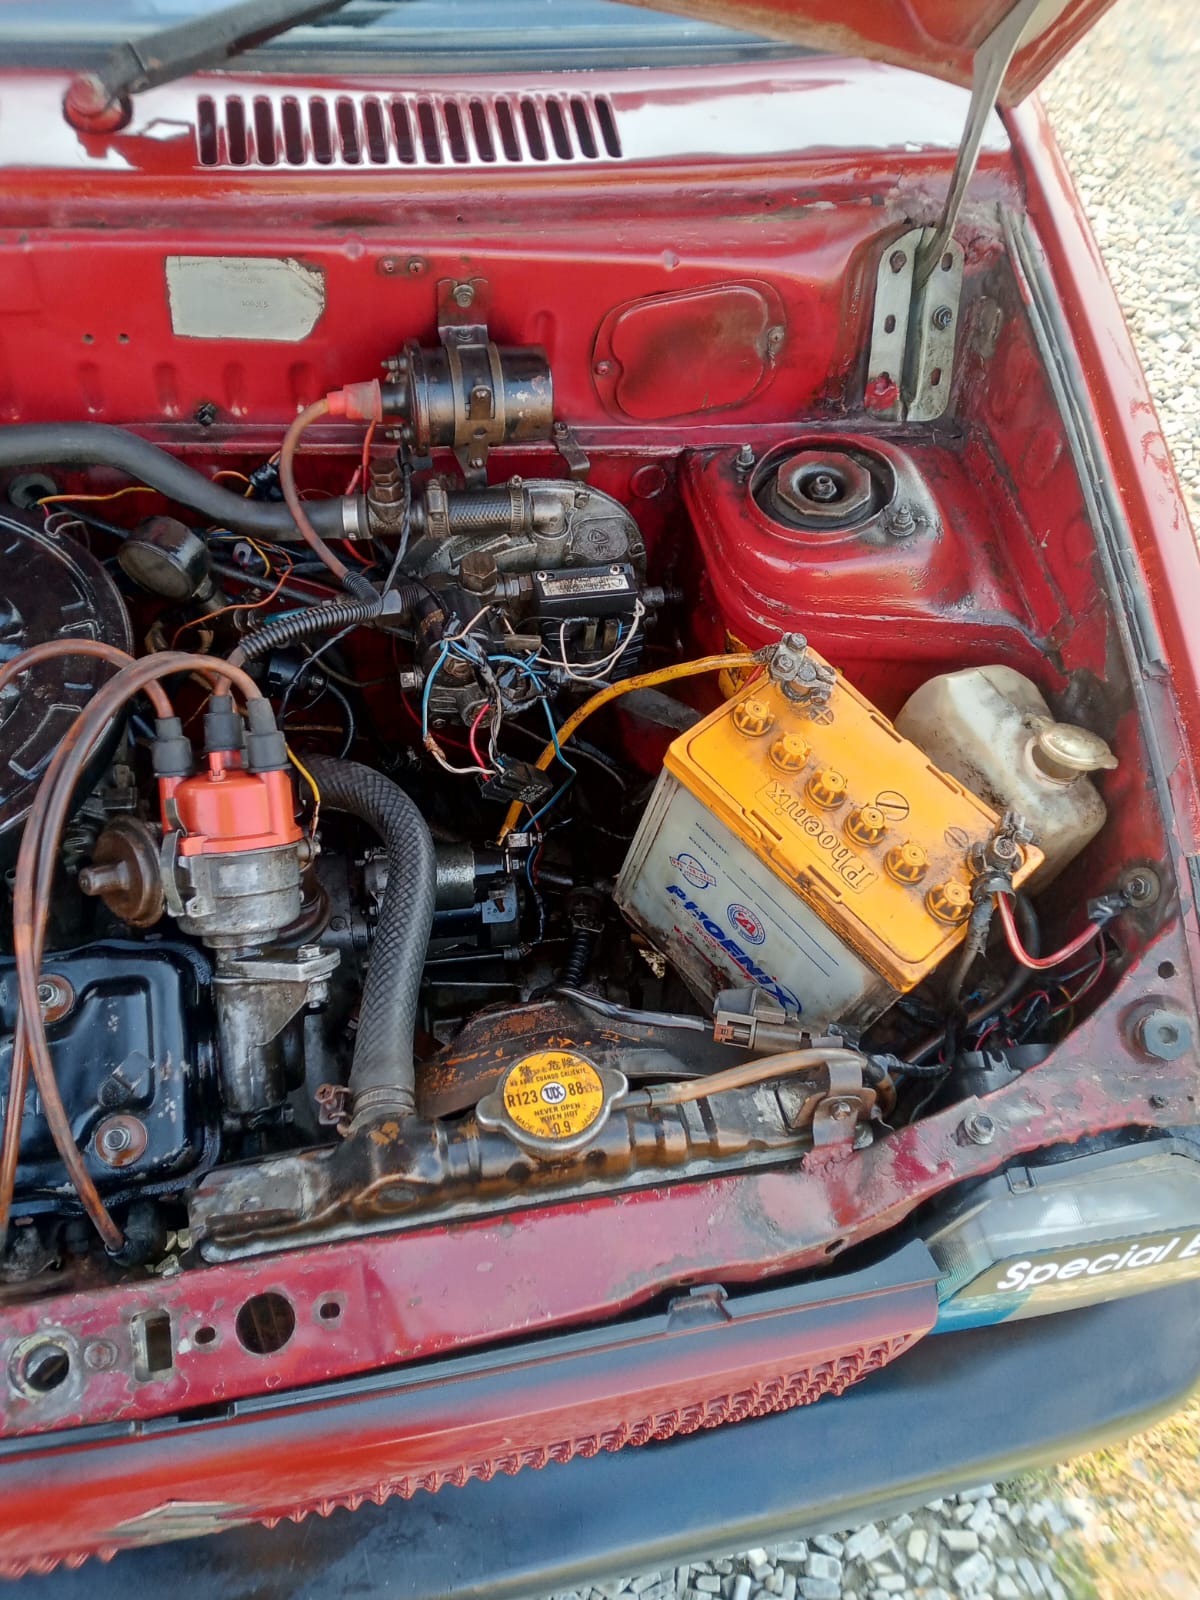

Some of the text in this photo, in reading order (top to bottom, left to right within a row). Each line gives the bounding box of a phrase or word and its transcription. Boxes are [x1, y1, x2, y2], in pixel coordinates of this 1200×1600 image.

[765, 782, 875, 889] Phoenix
[506, 1090, 539, 1108] R123
[534, 1103, 581, 1116] NEVER OPEN
[540, 1109, 579, 1123] WHEN HOT
[515, 1114, 535, 1131] MADE
[552, 1120, 572, 1135] 0.9
[997, 1236, 1181, 1292] Special
